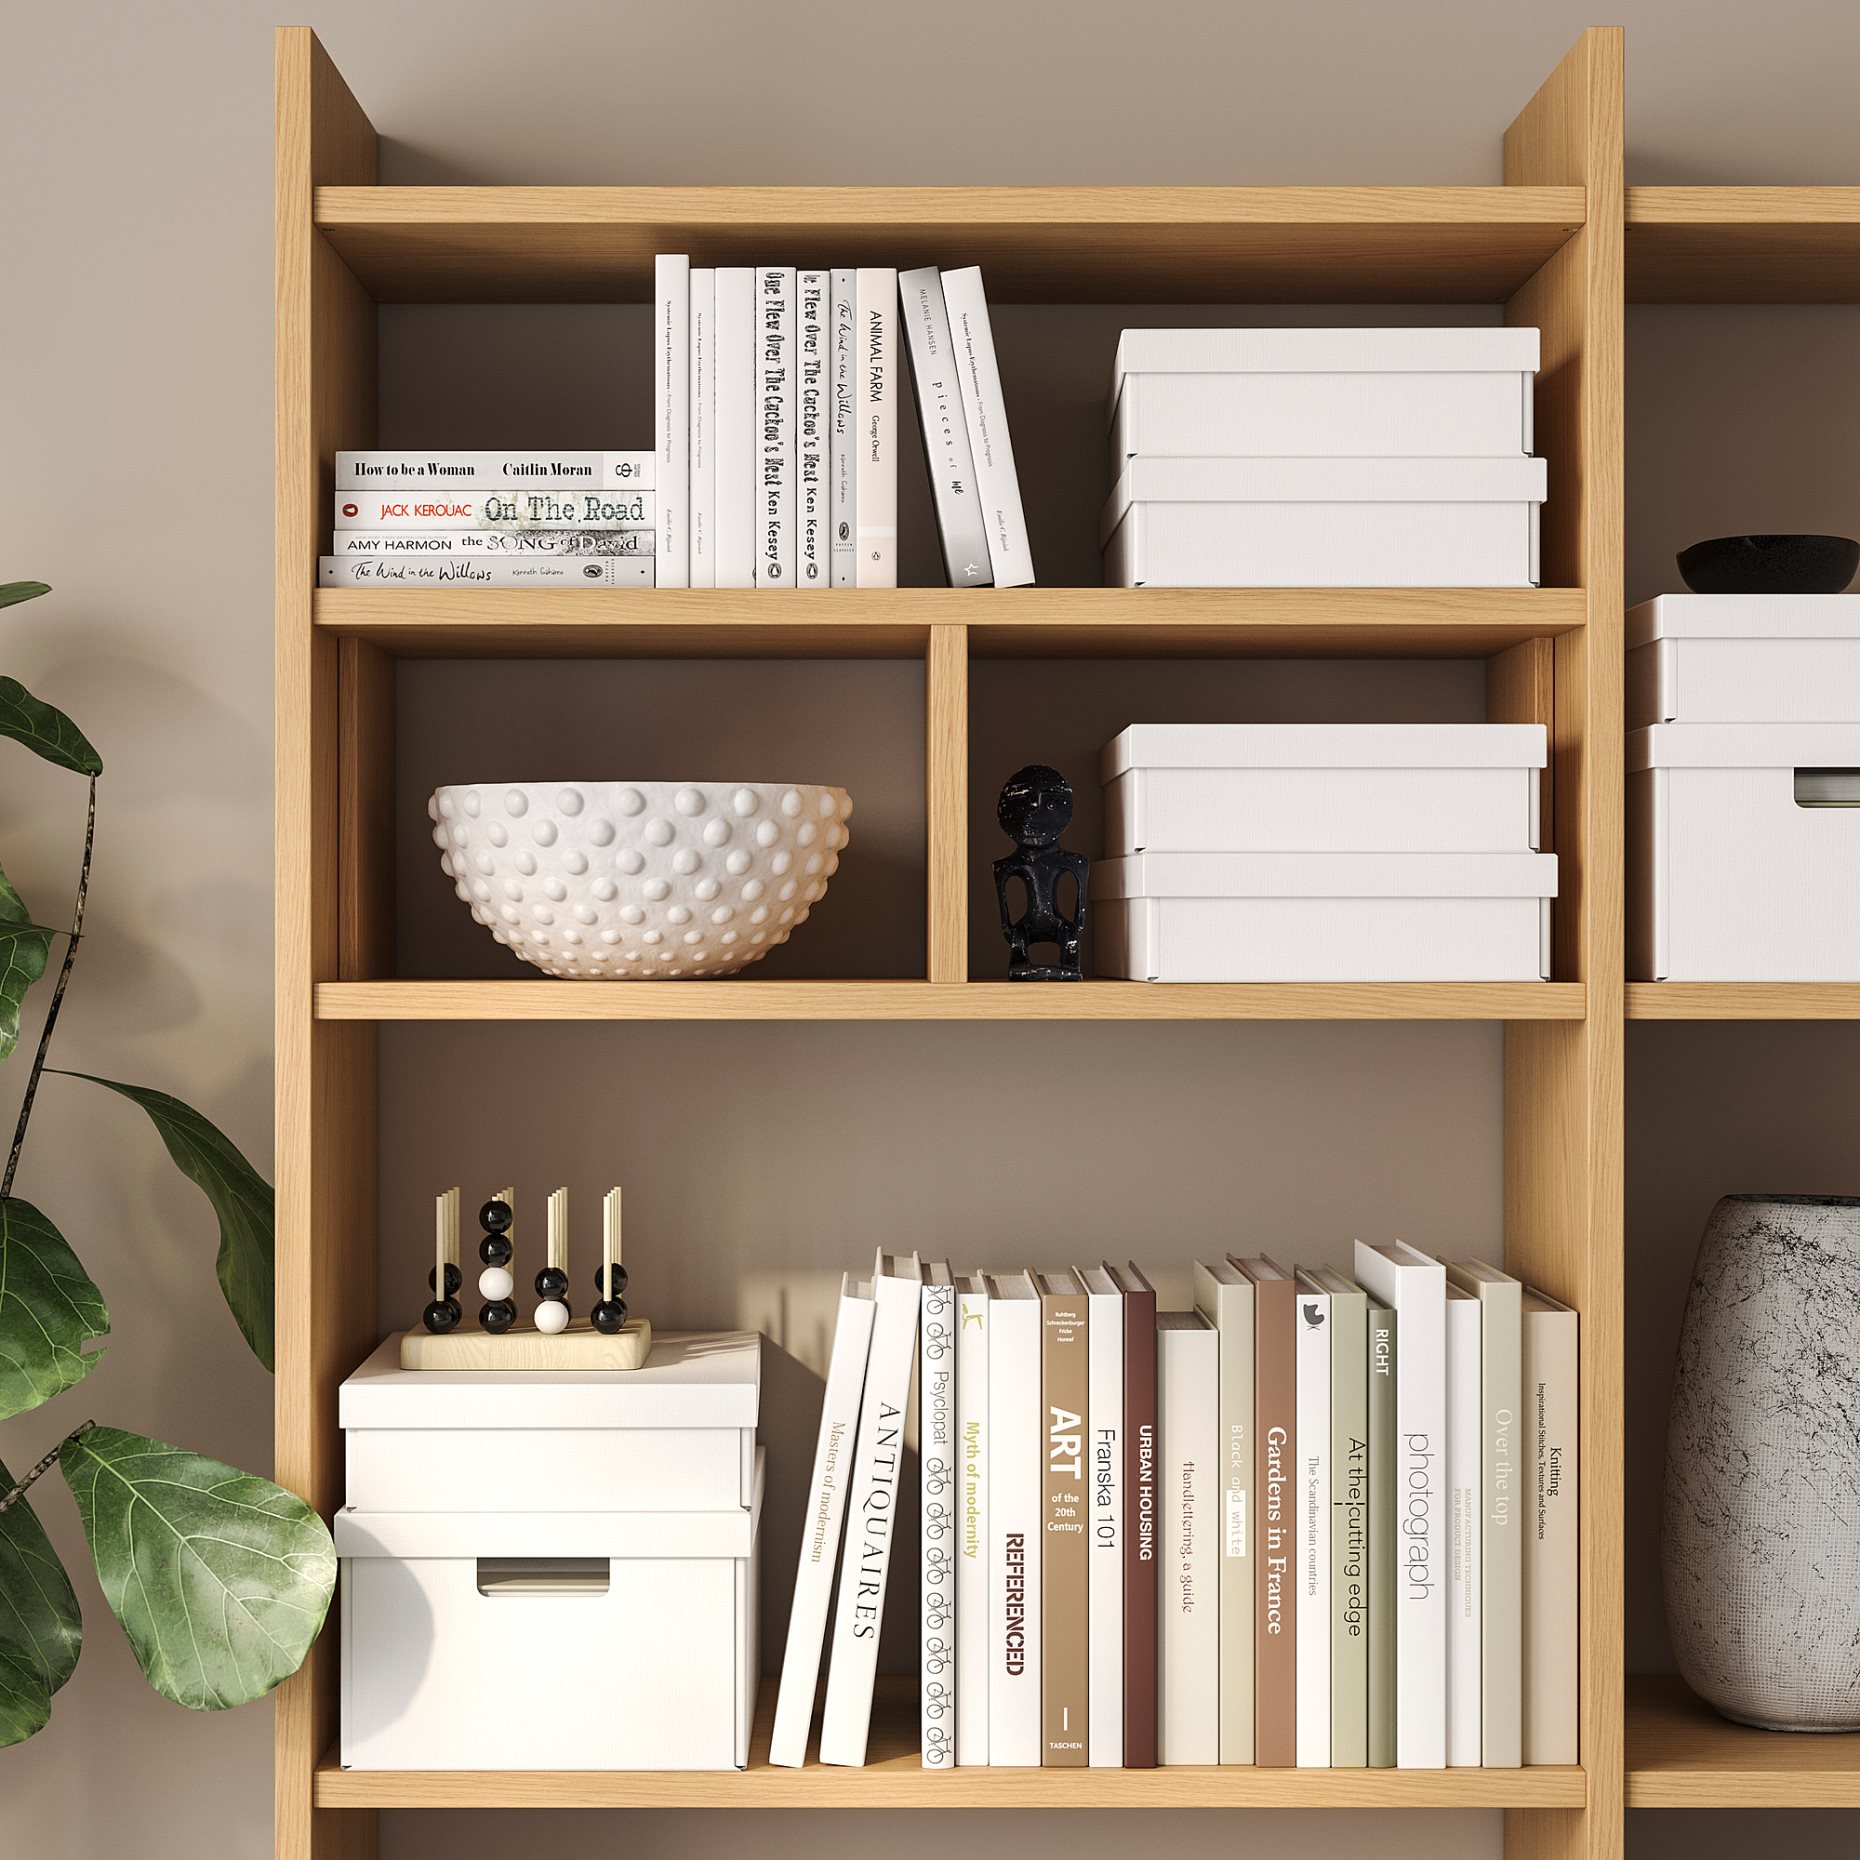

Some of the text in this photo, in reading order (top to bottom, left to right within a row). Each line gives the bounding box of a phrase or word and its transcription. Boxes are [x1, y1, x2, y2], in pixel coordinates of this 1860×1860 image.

[805, 289, 820, 320] Flew
[838, 300, 852, 320] The
[920, 289, 936, 355] MELANIE HANSEN
[804, 325, 820, 355] Over
[838, 324, 851, 351] Wind
[870, 311, 882, 402] ANIMAL FARM
[804, 360, 821, 384] The
[764, 273, 785, 560] One Flew Over The Cuckoo's Nest Ken Kesey
[804, 389, 819, 448] Cuckoo's
[837, 384, 852, 433] Willows
[871, 415, 880, 438] George
[932, 382, 952, 445] pieces
[949, 458, 957, 467] of
[355, 463, 474, 475] How to be a Woman
[503, 463, 591, 475] Caitlin Moran
[804, 454, 819, 482] Nest
[381, 504, 471, 520] JACK KEROUAC
[485, 496, 645, 521] On The Road
[807, 488, 816, 512] Ken
[348, 541, 451, 550] AMY HARMON
[461, 536, 483, 547] the
[487, 536, 558, 551] SONG
[580, 536, 639, 551] David
[804, 520, 817, 560] Kesey
[351, 561, 491, 580] The Wind in the Willows
[1376, 1329, 1390, 1376] RIGHT
[930, 1372, 949, 1444] Psyclopat
[1536, 1383, 1545, 1428] Inspirational
[1051, 1406, 1081, 1479] ART
[1538, 1430, 1546, 1459] Stitches,
[963, 1422, 980, 1558] Myth of modernity
[1097, 1430, 1115, 1547] Franska 101
[1230, 1425, 1244, 1555] Black and white
[1491, 1409, 1512, 1525] Over the top
[1547, 1448, 1561, 1496] Knitting
[811, 1422, 846, 1564] Masters of modernism
[1052, 1493, 1079, 1502] of the
[1055, 1508, 1075, 1516] 20th
[1140, 1426, 1152, 1560] URBAN HOUSING
[1403, 1434, 1434, 1599] photograph
[852, 1401, 901, 1640] ANTIQUAIRES
[1048, 1522, 1083, 1533] Century
[1268, 1427, 1286, 1634] Gardens in France
[1309, 1456, 1319, 1595] The Scandinavian countries
[1344, 1437, 1366, 1637] At the cutting edge
[1464, 1489, 1472, 1562] MANUFACTURING
[1006, 1534, 1024, 1675] REFERENCED
[1181, 1575, 1194, 1613] guide
